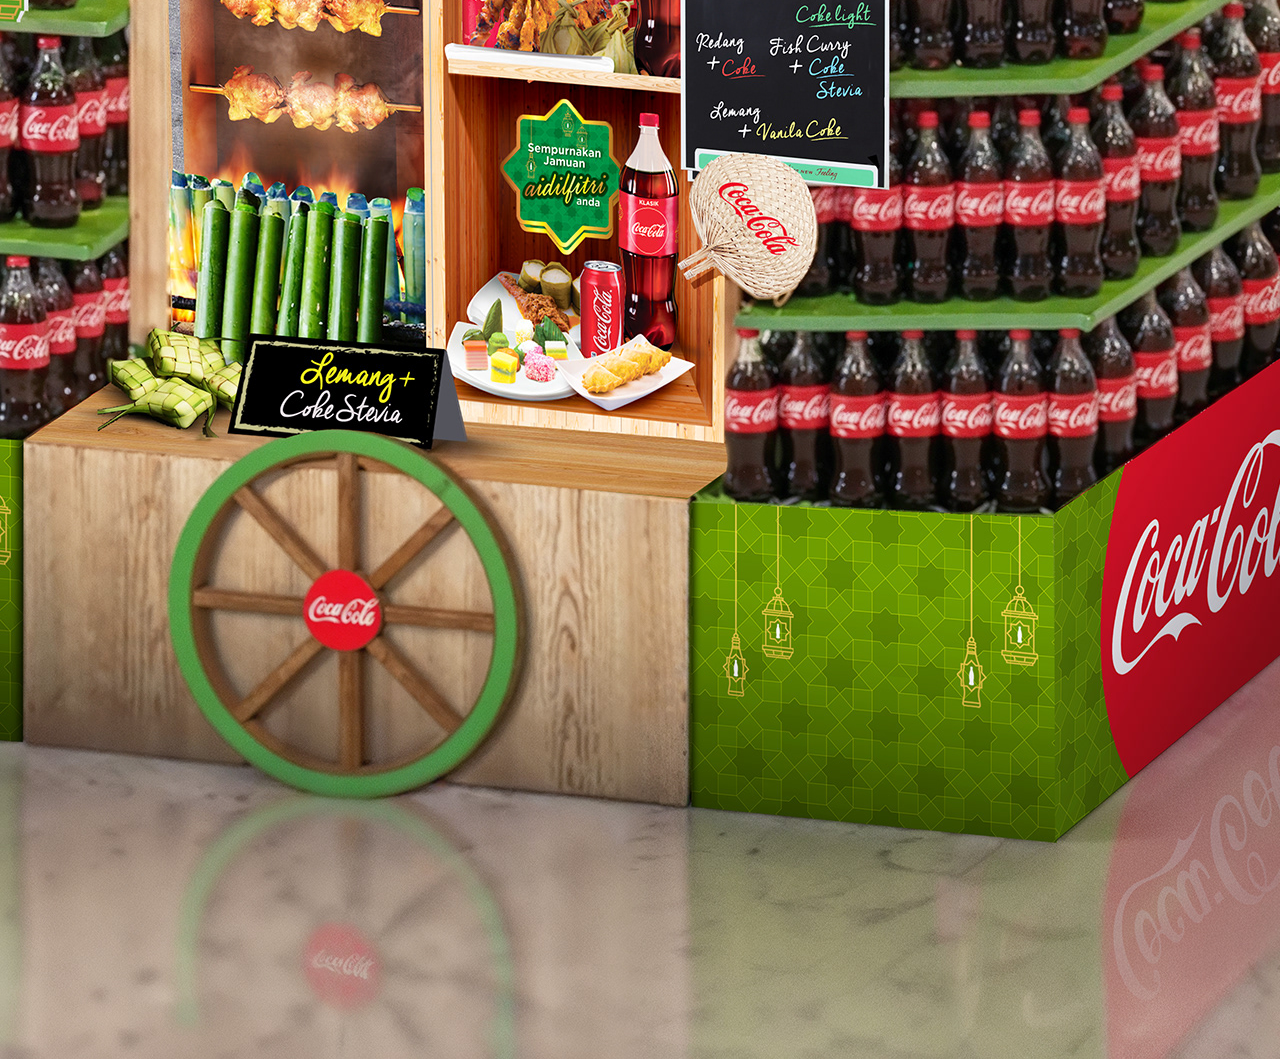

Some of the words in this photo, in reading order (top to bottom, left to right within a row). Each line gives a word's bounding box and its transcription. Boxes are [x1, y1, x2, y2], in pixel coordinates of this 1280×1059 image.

[795, 4, 833, 24] Coke
[834, 2, 871, 30] light
[769, 36, 803, 57] Fish
[806, 35, 852, 58] Curry
[721, 56, 758, 76] Coke
[808, 55, 846, 77] Coke
[816, 80, 863, 99] Stevia
[709, 100, 761, 123] Lemang
[756, 121, 804, 141] Vanila
[806, 118, 843, 138] Coke
[527, 142, 602, 160] Sempurnakan
[543, 156, 586, 169] Jamuan
[525, 172, 606, 205] aidilfitri
[576, 196, 601, 207] anda
[300, 351, 395, 403] Lemang
[280, 390, 335, 421] Coke
[335, 393, 403, 424] Stevia
